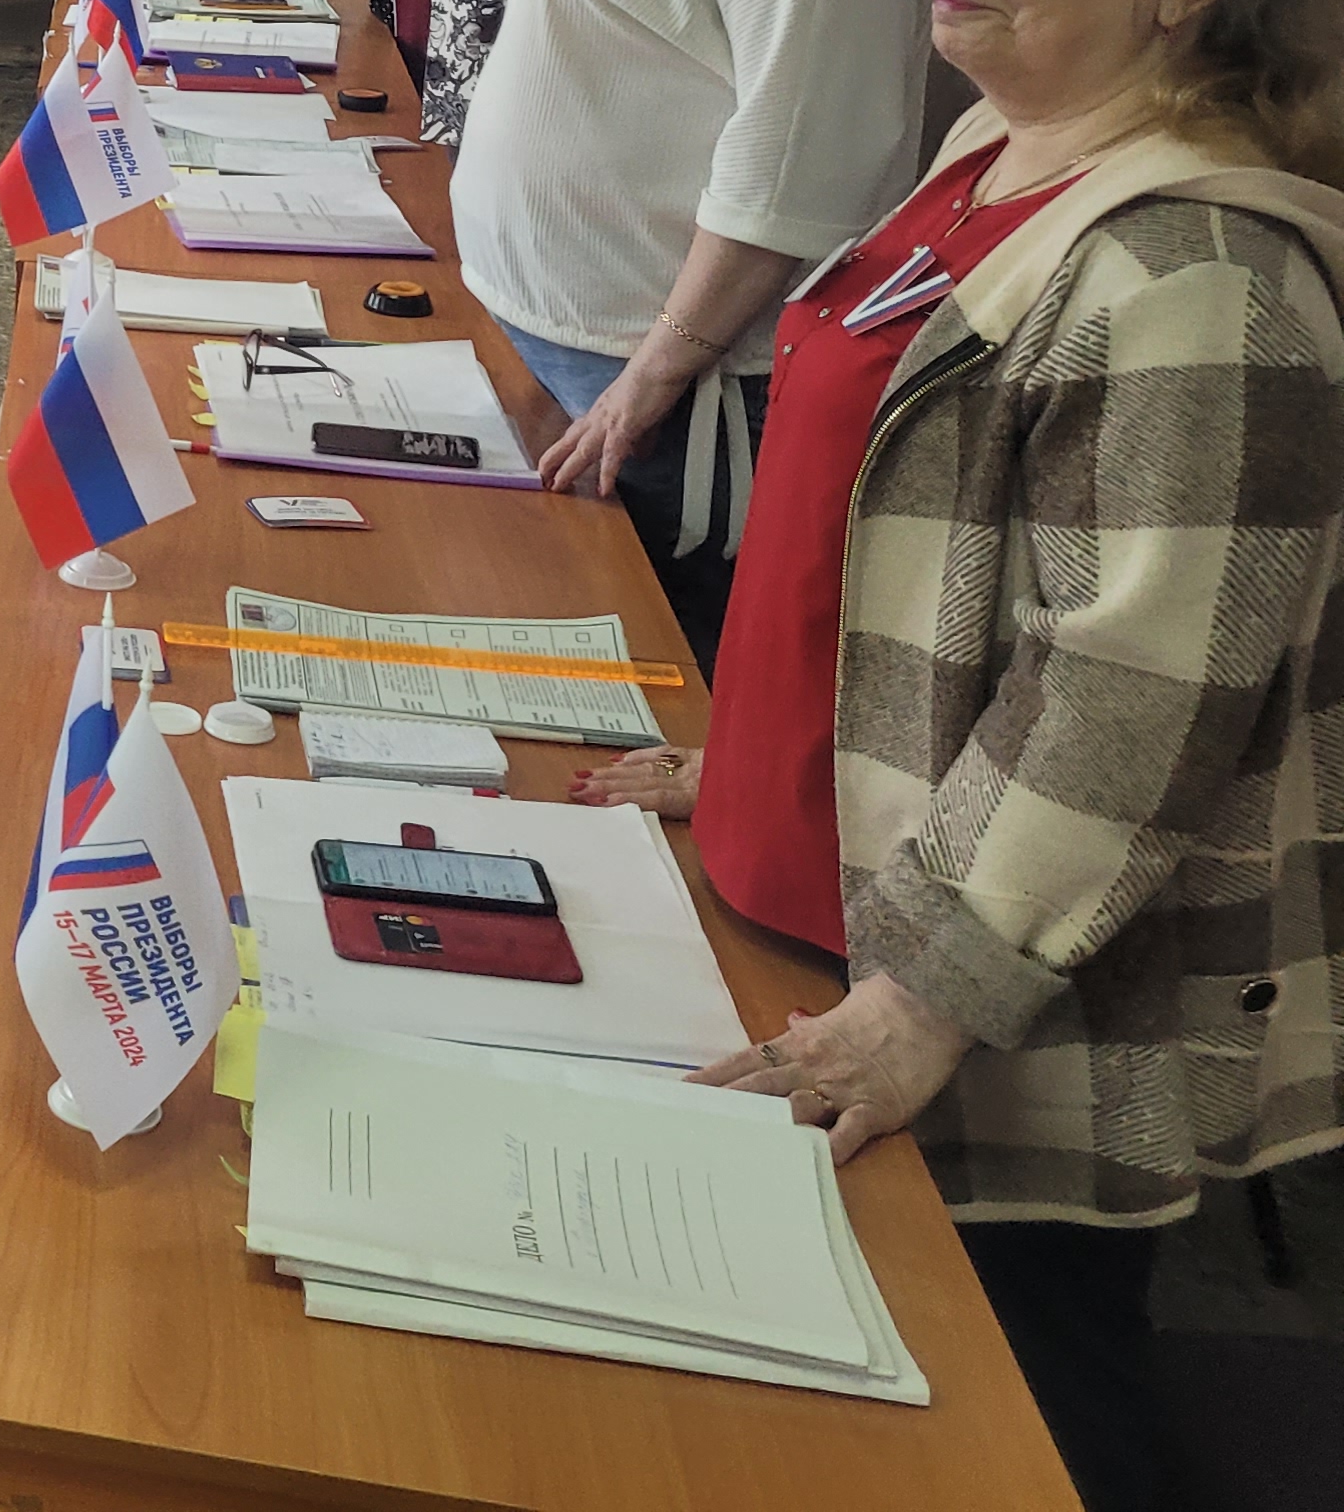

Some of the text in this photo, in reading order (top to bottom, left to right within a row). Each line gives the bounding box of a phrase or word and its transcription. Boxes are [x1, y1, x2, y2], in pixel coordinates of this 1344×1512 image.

[97, 130, 132, 199] ПРЕЗИДЕНТА
[112, 128, 141, 176] ВЫБОРЫ
[80, 908, 151, 1005] РОССИИ
[116, 902, 195, 1046] ПРЕЗИДЕНТА
[149, 894, 203, 994] ВЫБОРЫ
[78, 964, 128, 1025] МАРТА
[113, 1025, 148, 1068] 2024
[512, 1225, 544, 1263] ДЕЛО
